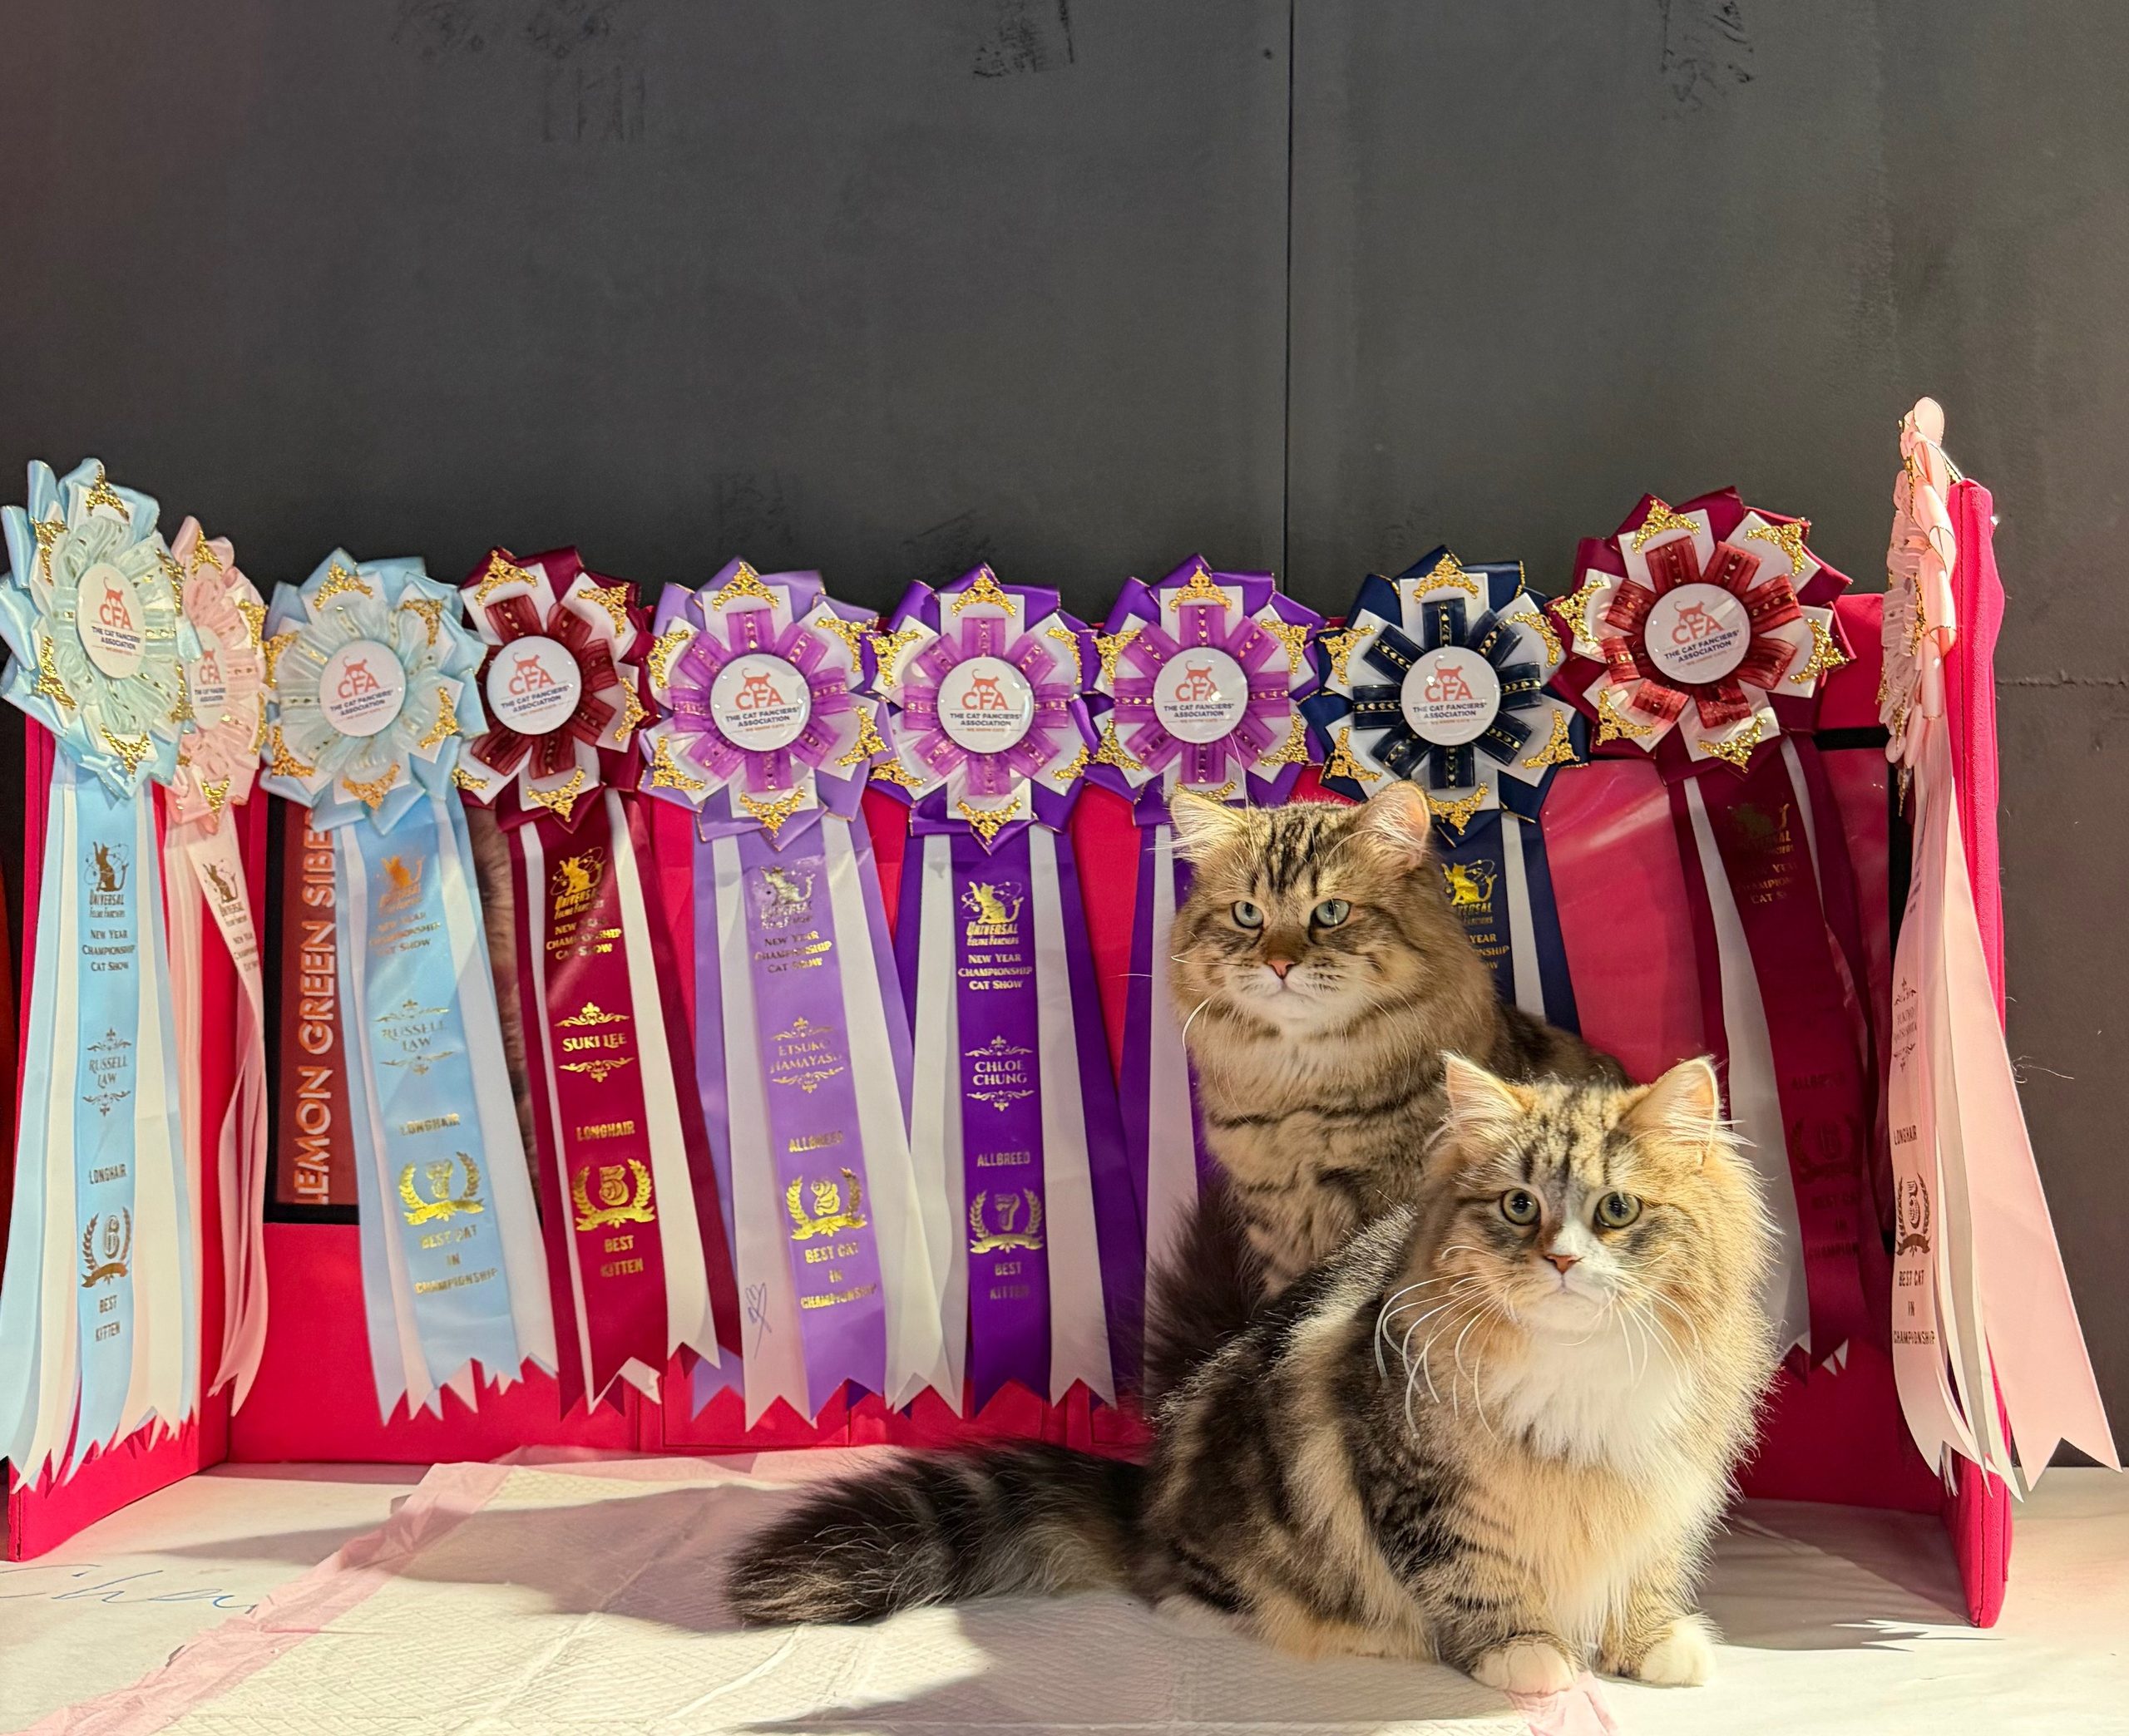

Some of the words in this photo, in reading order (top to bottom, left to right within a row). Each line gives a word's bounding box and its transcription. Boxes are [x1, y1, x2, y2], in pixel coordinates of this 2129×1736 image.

[99, 604, 134, 631] CFA
[1672, 616, 1725, 645] CFA
[1664, 650, 1680, 659] THE
[1682, 644, 1697, 653] CAT
[1698, 629, 1740, 648] FANCIERS'
[1678, 640, 1731, 663] ASSOCIATION
[200, 665, 222, 684] CFA
[509, 668, 556, 695] CFA
[338, 672, 380, 698] CFA
[1175, 682, 1220, 702] CFA
[1425, 681, 1474, 703] CFA
[341, 699, 385, 715] ASSOCIATION
[513, 695, 561, 713] ASSOCIATION
[516, 696, 530, 704] CAT
[735, 688, 785, 710] CFA
[961, 692, 1009, 710] CFA
[738, 715, 790, 727] ASSOCIATION
[759, 707, 800, 717] FANCIERS'
[1424, 711, 1476, 719] ASSOCIATION
[90, 889, 124, 905] UNIVERSAL
[1750, 893, 1773, 904] CAT
[91, 929, 106, 940] NEW
[109, 929, 128, 939] YEAR
[555, 923, 576, 935] NEW
[966, 921, 1018, 936] UNIVERSAL
[400, 939, 431, 951] SHOW
[546, 929, 622, 950] CHAMOSHIP
[765, 937, 788, 946] NEW
[791, 930, 819, 943] YEAR
[1470, 934, 1497, 944] YEAR
[82, 944, 136, 955] CHAMPIONSHIP
[556, 948, 574, 960] CA
[579, 943, 612, 956] SOW
[754, 940, 832, 960] CHAMPIONSHIP
[968, 954, 991, 964] NEW
[995, 953, 1022, 963] YEAR
[91, 962, 106, 972] CAT
[108, 962, 129, 971] SHOW
[768, 964, 788, 973] CAT
[958, 966, 1032, 977] CHAMPIONSHIP
[298, 920, 336, 1054] GREEN
[969, 980, 990, 990] CAT
[992, 979, 1023, 989] SHOW
[382, 1020, 446, 1041] RUSSELL
[403, 1037, 431, 1052] LAW
[562, 1035, 600, 1052] SUKI
[602, 1033, 626, 1048] LEE
[89, 1055, 128, 1073] RUSSELL
[975, 1060, 1025, 1073] CHLOE
[97, 1073, 117, 1089] LAW
[973, 1073, 1027, 1086] CHUNG
[575, 1120, 635, 1142] LONGHAIR
[1894, 1125, 1917, 1146] LONGHAIR
[788, 1130, 843, 1152] ALLBREED
[977, 1152, 1030, 1167] ALLBREED
[89, 1164, 126, 1184] LONGHAIR
[599, 1165, 630, 1206] 5
[811, 1177, 841, 1216] 2
[995, 1193, 1020, 1231] 7
[103, 1215, 120, 1260] 6
[420, 1230, 451, 1250] BEST
[455, 1224, 477, 1242] CAT
[604, 1235, 634, 1253] BEST
[447, 1253, 461, 1266] IN
[805, 1246, 834, 1264] BEST
[837, 1242, 858, 1257] CAT
[600, 1257, 644, 1278] KITTEN
[829, 1269, 842, 1283] IN
[995, 1261, 1021, 1276] BEST
[414, 1268, 498, 1295] CHAMPIONSHIP
[1899, 1270, 1912, 1286] BEST
[1914, 1270, 1924, 1286] CAT
[99, 1295, 117, 1314] BEST
[800, 1284, 877, 1309] CHAMPIONSHIP
[1908, 1300, 1915, 1316] IN
[96, 1321, 121, 1342] KITTEN
[1894, 1330, 1935, 1344] CHAMPIONSHIP
